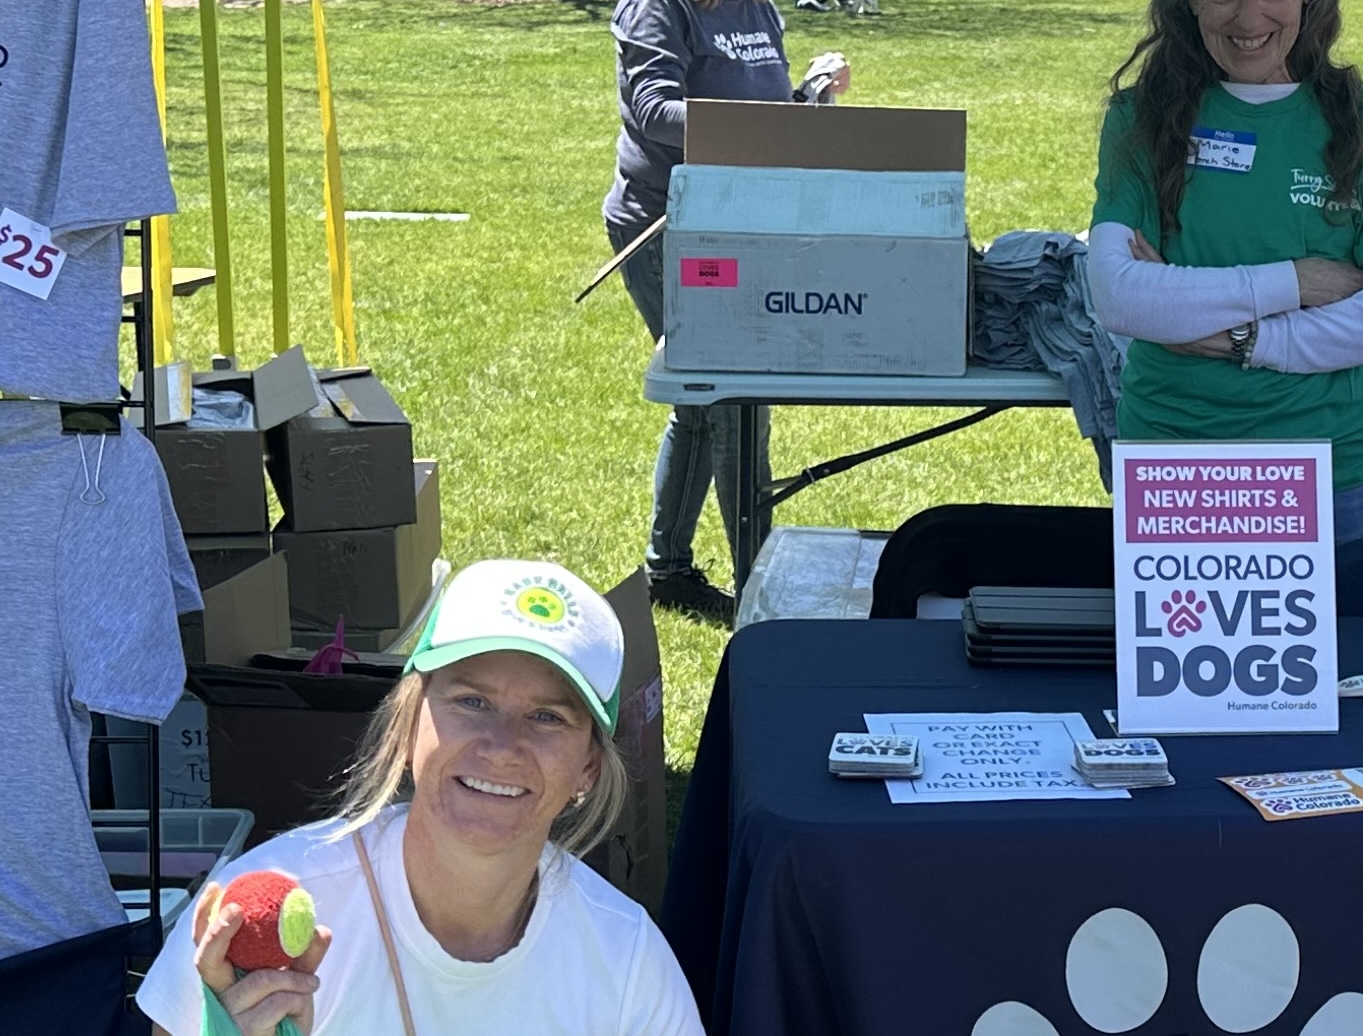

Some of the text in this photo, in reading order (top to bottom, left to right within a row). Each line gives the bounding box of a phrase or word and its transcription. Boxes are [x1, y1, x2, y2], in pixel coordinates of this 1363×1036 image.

[1197, 139, 1240, 154] Marie
[0, 224, 60, 279] $25
[1136, 465, 1305, 482] SHOW YOUR LOVE
[1143, 489, 1299, 508] NEW SHIRTS &
[1136, 516, 1306, 535] MERCHANDISE!
[1133, 554, 1314, 581] COLORADO
[1136, 644, 1318, 697] DOGS
[1227, 700, 1318, 711] Humane Colorado
[181, 729, 210, 750] $1
[953, 732, 1015, 740] CARD
[835, 745, 912, 756] CATS
[932, 740, 1042, 749] OR EXACT
[942, 748, 1042, 757] CHANGE
[1083, 749, 1161, 757] DOGS
[940, 771, 1063, 780] ALL PRICES
[925, 780, 1028, 789] INCLUDE
[1293, 792, 1361, 811] Humane Colorado
